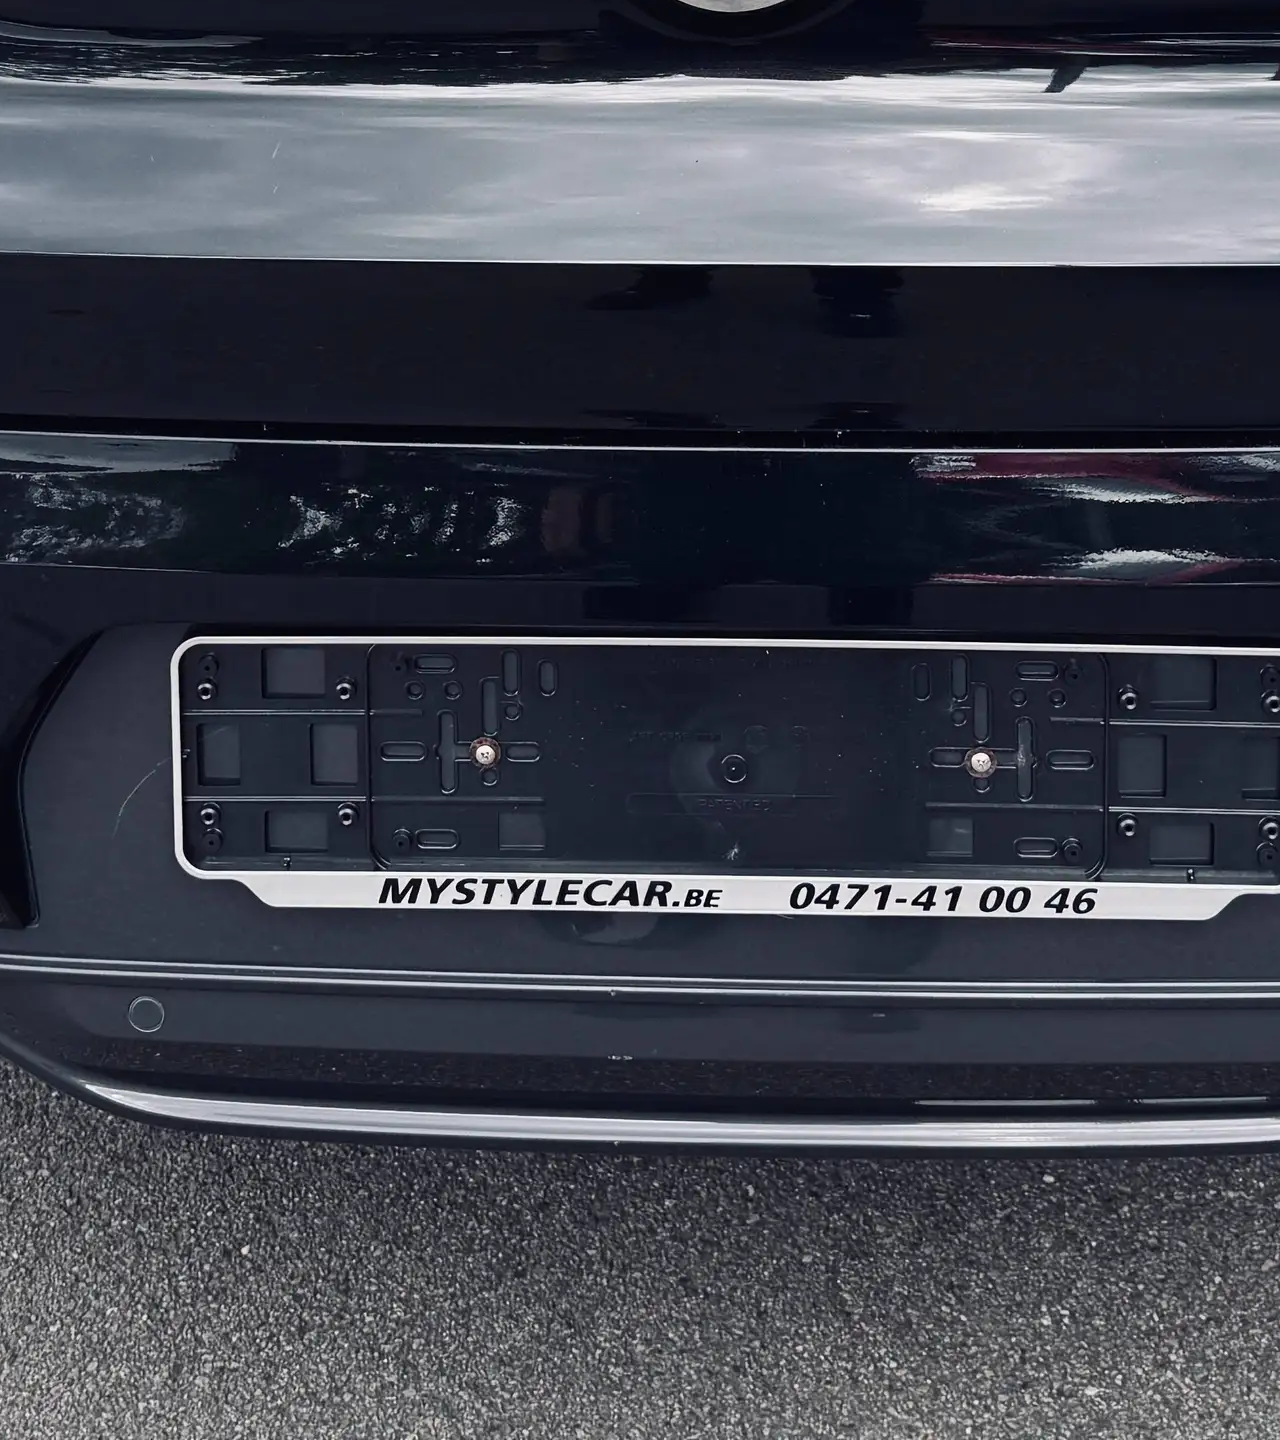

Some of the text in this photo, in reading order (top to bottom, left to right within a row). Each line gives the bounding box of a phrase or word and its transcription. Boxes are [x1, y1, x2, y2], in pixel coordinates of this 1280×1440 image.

[378, 878, 1098, 914] MYSTYLECAR.BE 0471-41 00 46
